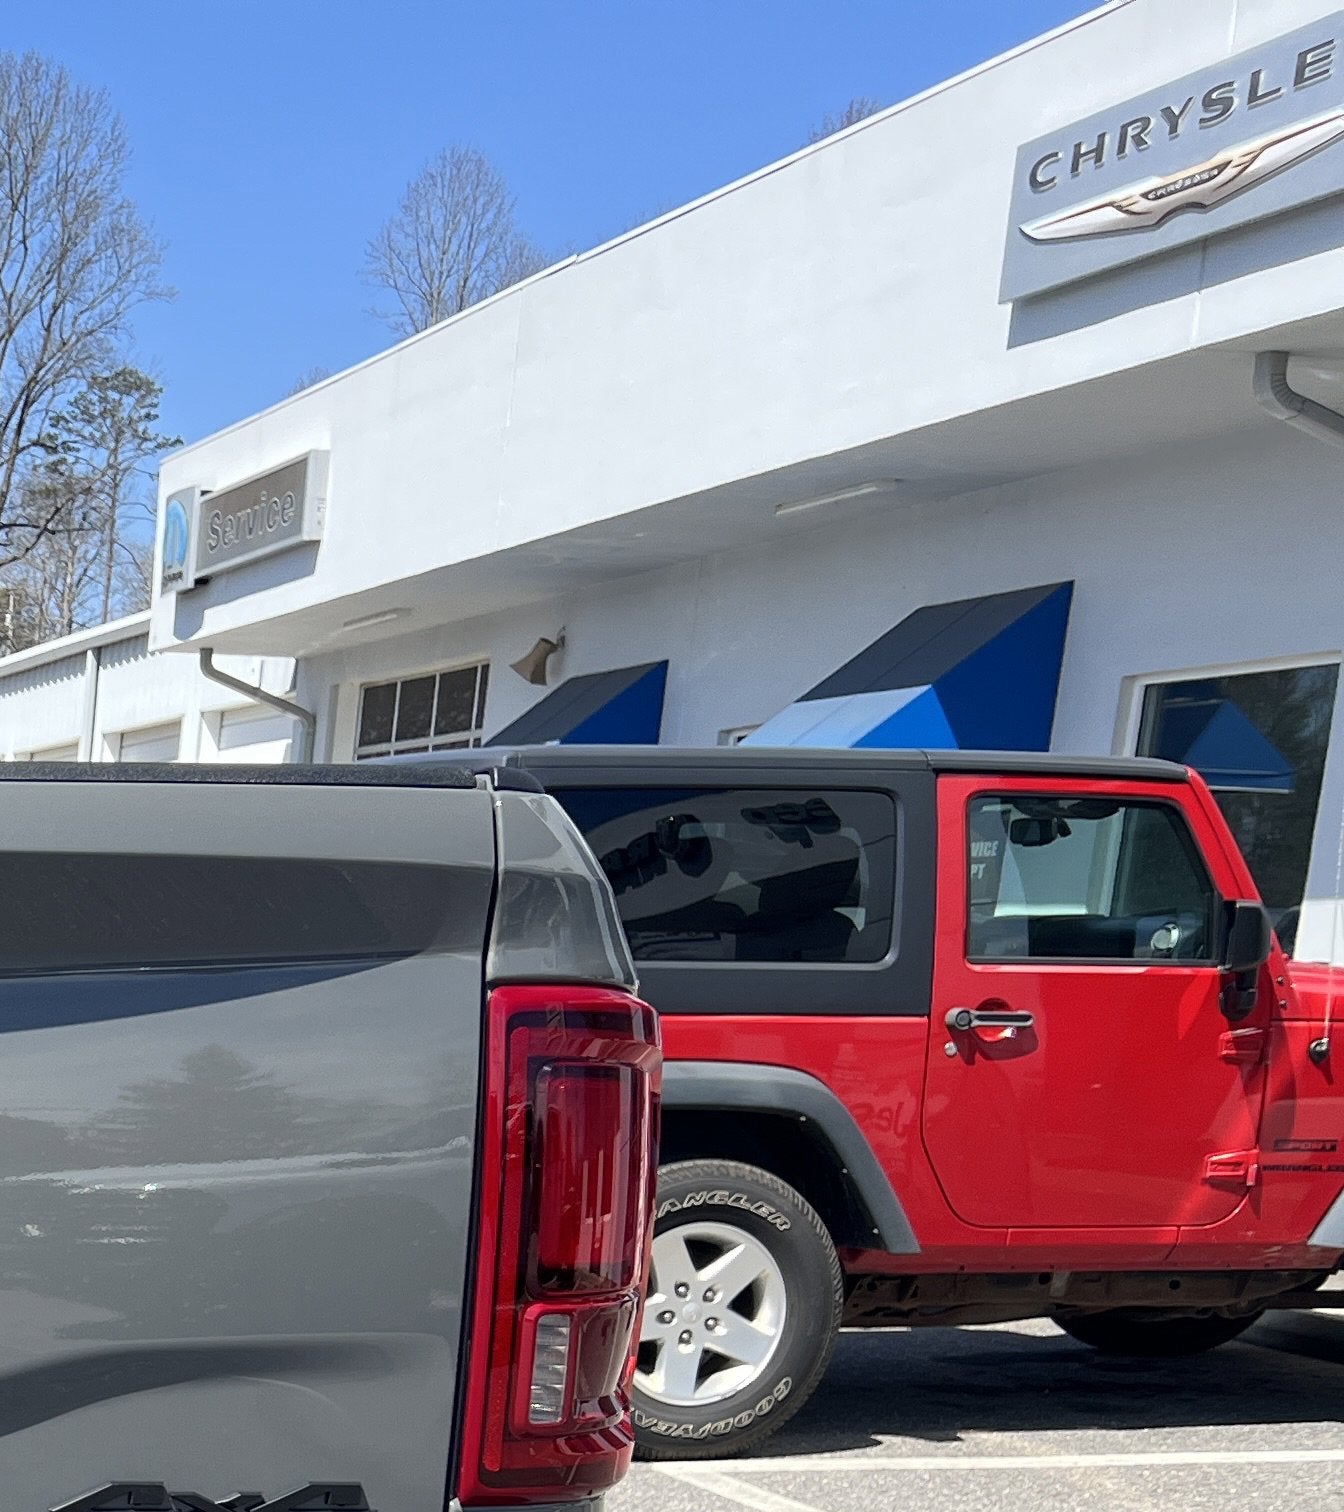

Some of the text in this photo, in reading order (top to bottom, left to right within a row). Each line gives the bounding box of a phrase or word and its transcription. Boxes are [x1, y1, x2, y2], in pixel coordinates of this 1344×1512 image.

[1028, 38, 1335, 193] CHRYSLE
[207, 489, 295, 553] Service
[655, 1190, 791, 1232] ANGLER
[631, 1376, 792, 1439] GOODYEA
